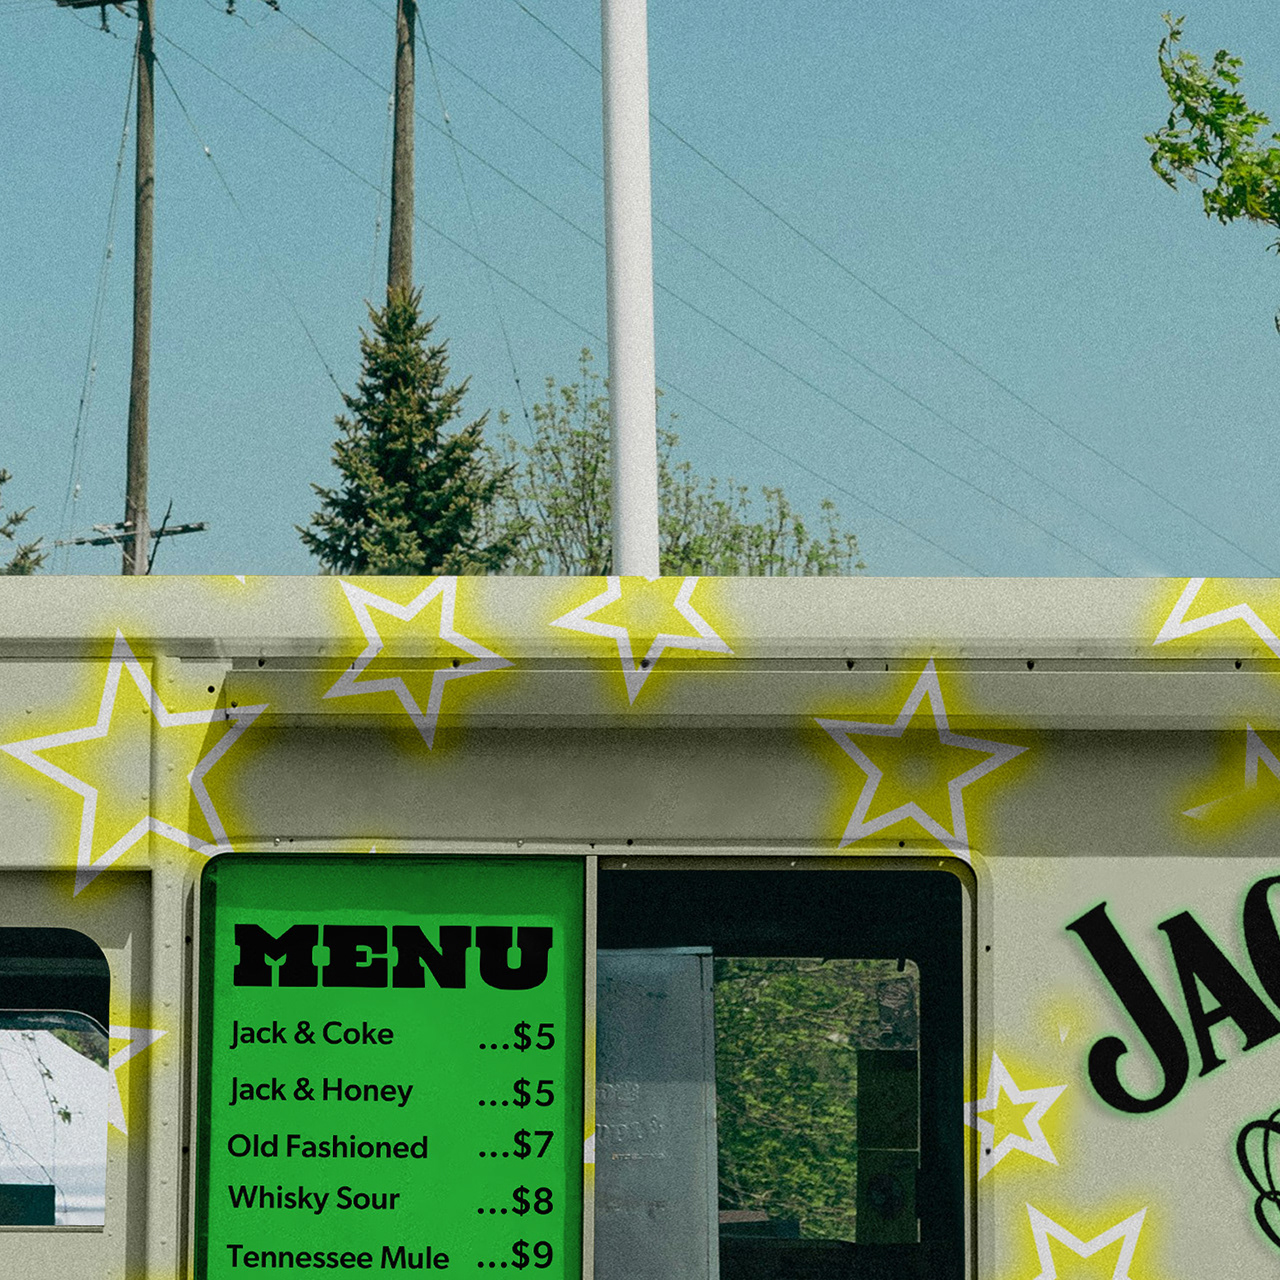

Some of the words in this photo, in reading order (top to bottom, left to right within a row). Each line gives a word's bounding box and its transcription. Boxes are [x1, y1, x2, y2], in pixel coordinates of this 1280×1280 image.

[232, 923, 554, 991] MENU
[228, 1020, 287, 1050] Jack
[293, 1020, 316, 1045] &
[322, 1020, 394, 1046] Coke
[228, 1076, 287, 1107] Jack
[292, 1076, 315, 1102] &
[322, 1076, 414, 1108] Honey
[227, 1133, 279, 1158] Old
[286, 1133, 428, 1160] Fashioned
[227, 1184, 330, 1216] Whisky
[336, 1185, 401, 1210] Sour
[226, 1243, 374, 1270] Tennessee
[380, 1245, 450, 1270] Mule
